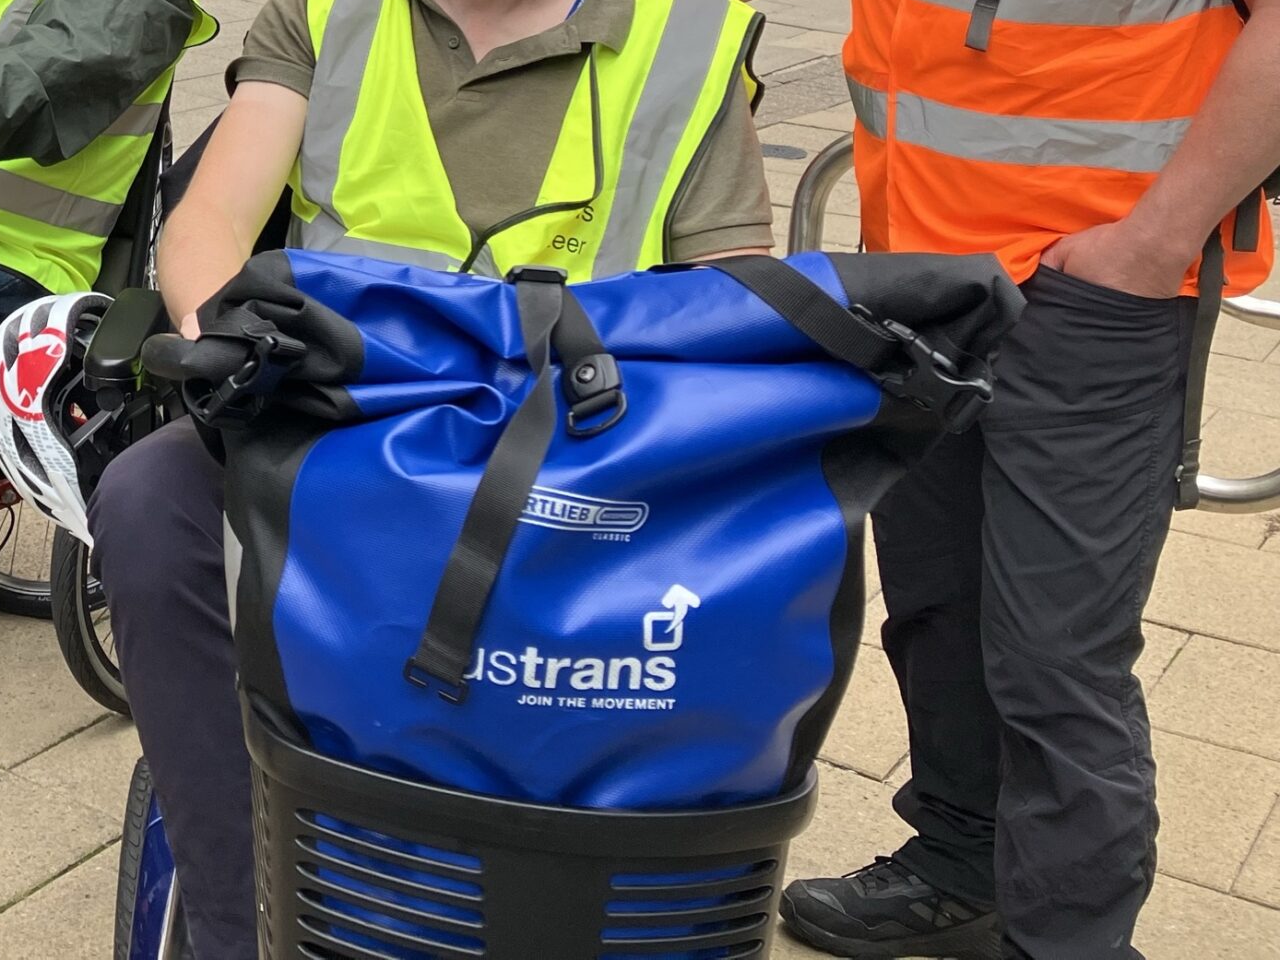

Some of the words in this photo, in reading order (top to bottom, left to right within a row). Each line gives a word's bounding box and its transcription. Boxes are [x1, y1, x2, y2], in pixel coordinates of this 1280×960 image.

[526, 496, 590, 521] RTLIEB
[592, 533, 631, 542] CLASSIC
[463, 646, 677, 692] ustrans
[517, 695, 552, 707] JOIN
[557, 696, 586, 708] THE
[591, 697, 677, 710] MOVEMENT
